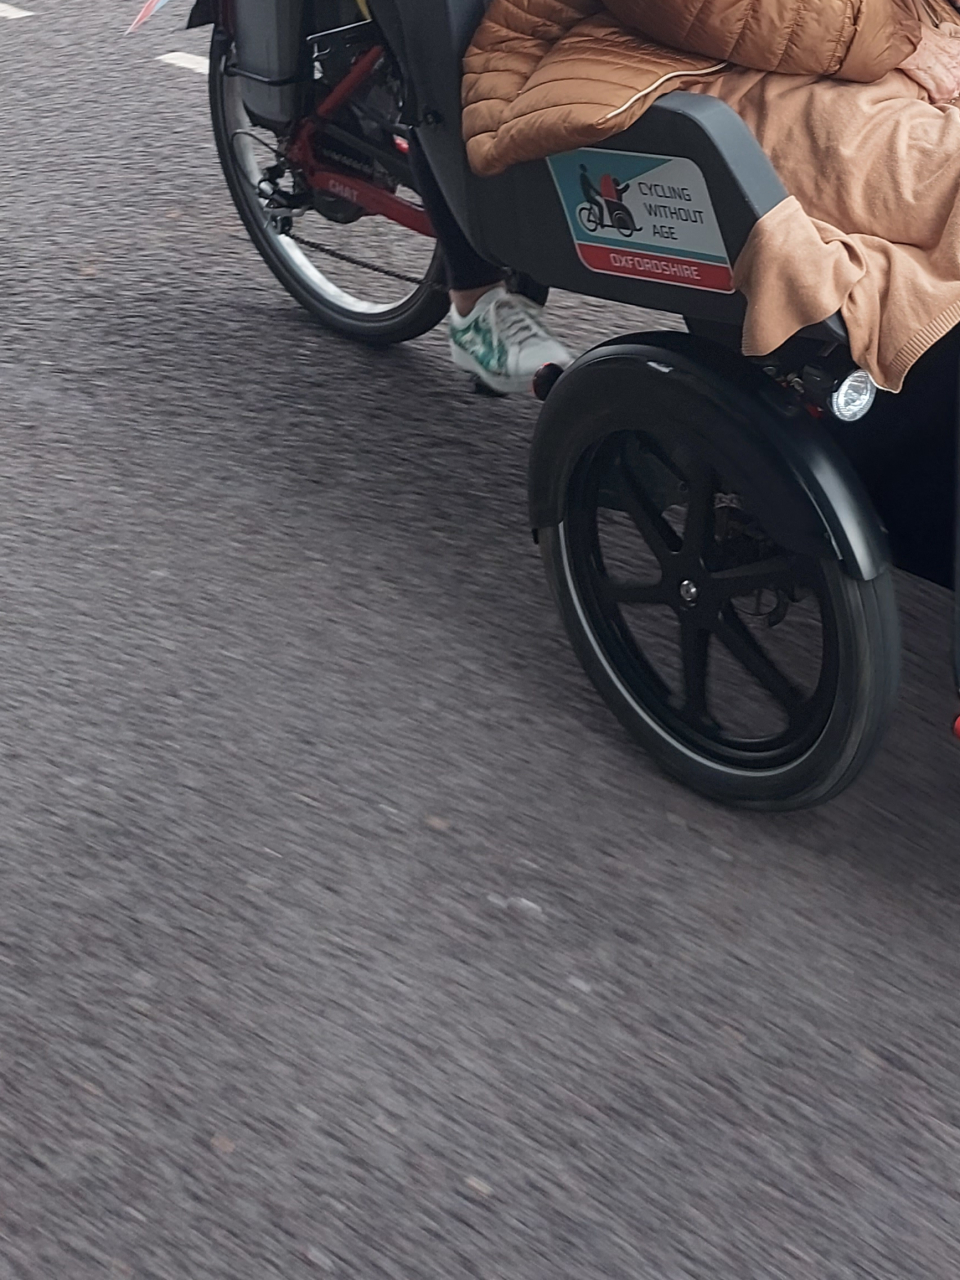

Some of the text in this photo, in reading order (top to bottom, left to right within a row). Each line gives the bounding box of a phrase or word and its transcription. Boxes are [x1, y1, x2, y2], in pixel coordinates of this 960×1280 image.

[637, 182, 692, 202] CYCLING
[643, 202, 705, 225] WITHOUT
[652, 224, 679, 241] AGE
[609, 253, 702, 280] OXFORDSHIRE
